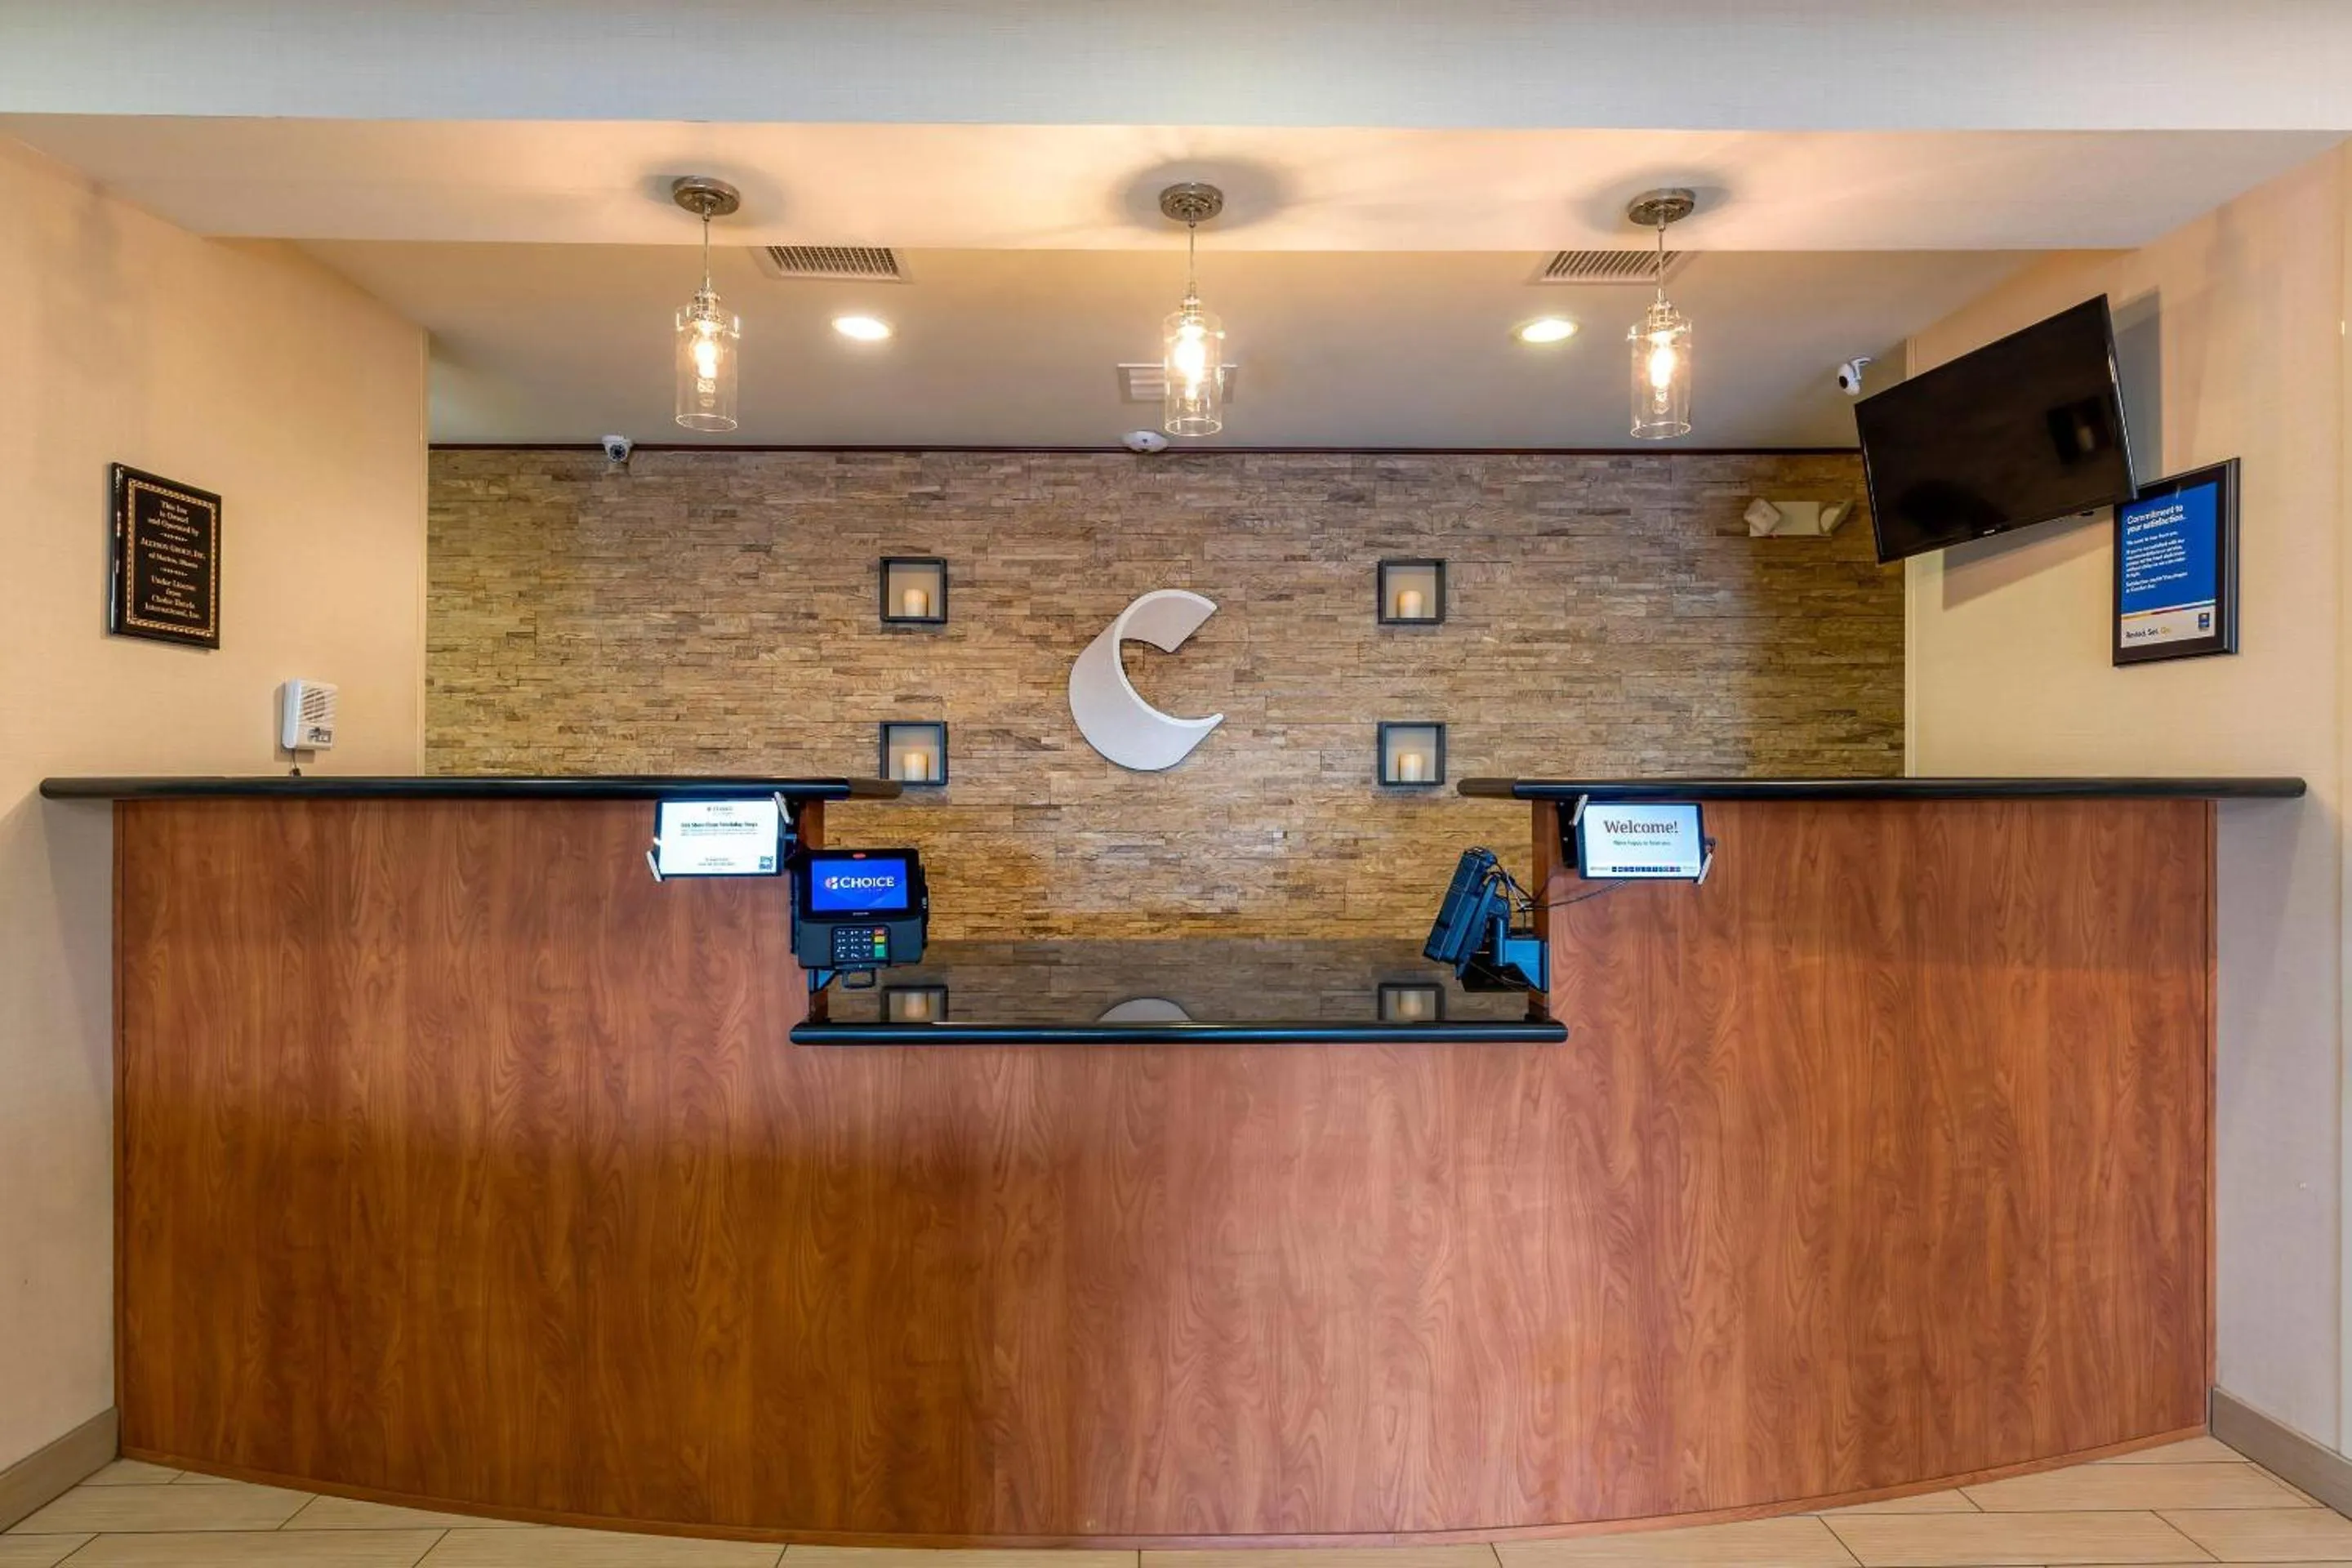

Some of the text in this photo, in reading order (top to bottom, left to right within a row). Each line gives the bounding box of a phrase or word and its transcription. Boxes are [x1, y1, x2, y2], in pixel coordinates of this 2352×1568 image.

[2127, 505, 2175, 524] Commitment
[1603, 819, 1679, 834] Welcome!
[840, 875, 895, 889] CHOICE
